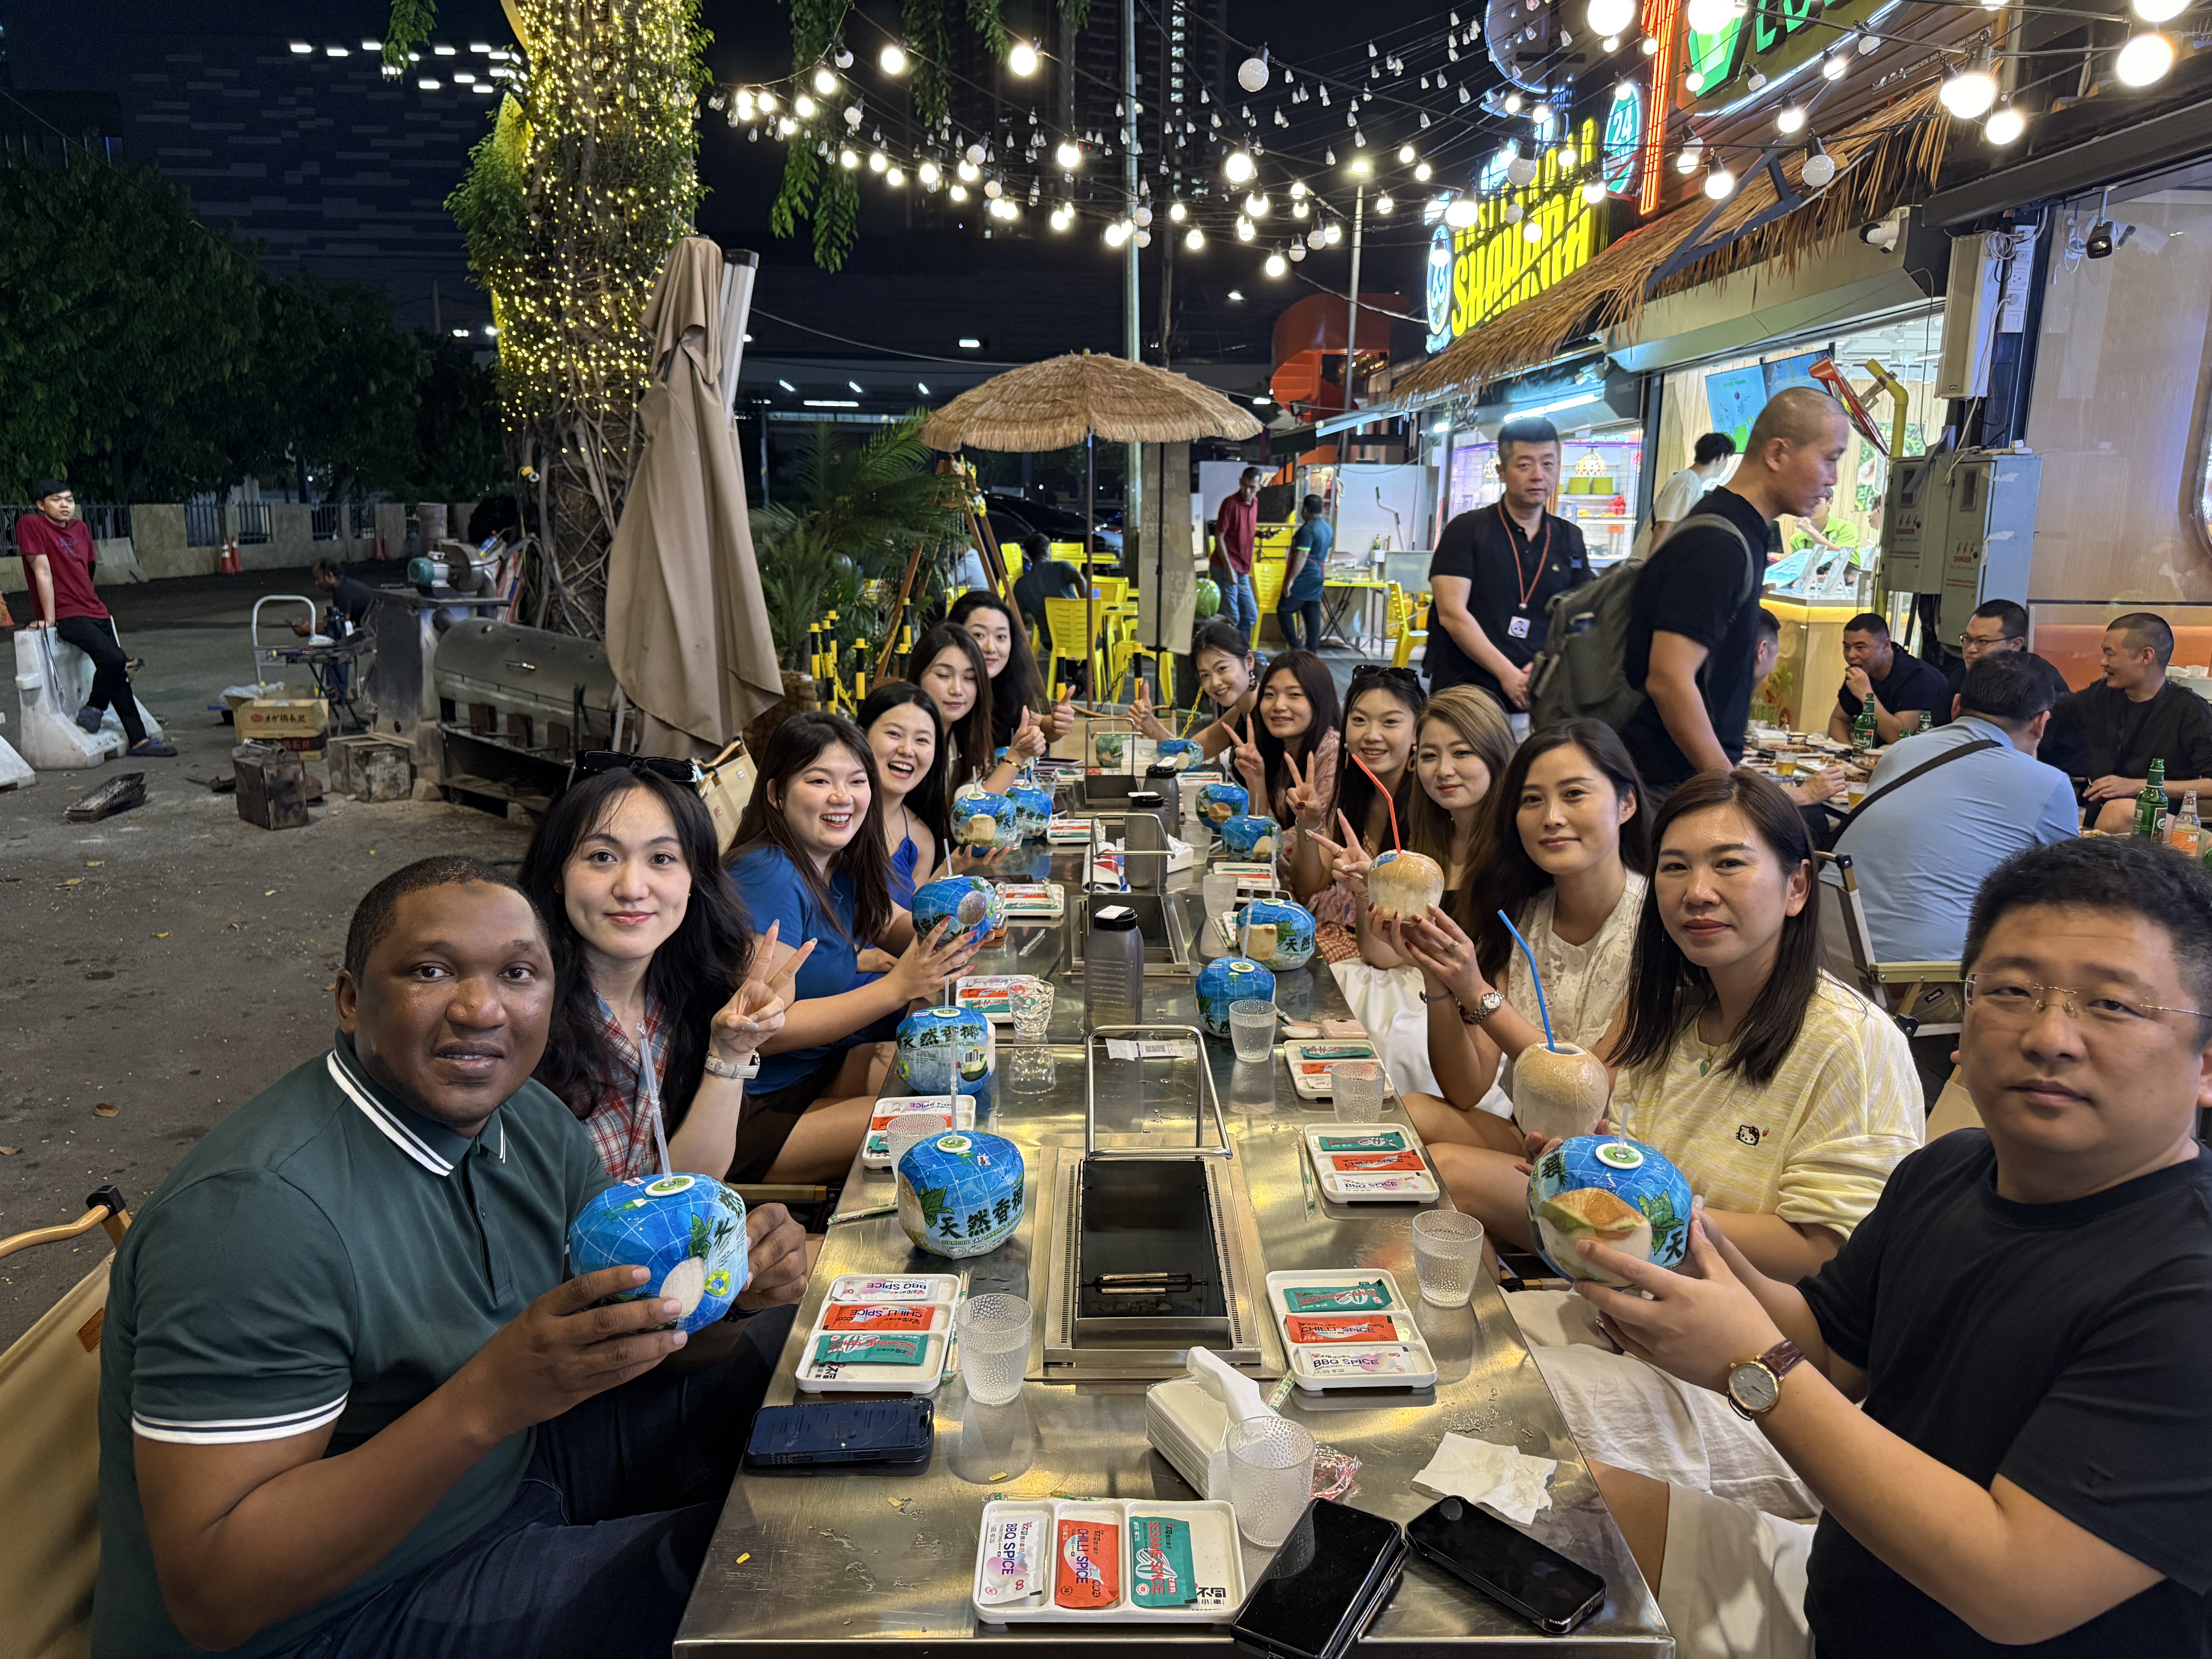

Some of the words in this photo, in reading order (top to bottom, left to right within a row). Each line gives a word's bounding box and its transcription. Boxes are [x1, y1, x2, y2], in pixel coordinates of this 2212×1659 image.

[1611, 101, 1632, 151] 24
[984, 1225, 1006, 1240] PANDAN
[1314, 1359, 1339, 1368] BBQ
[1004, 1523, 1018, 1540] BBQ
[1077, 1528, 1089, 1552] CHILLI
[1149, 1522, 1163, 1559] SESAME
[1001, 1542, 1016, 1575] SPICE
[1076, 1556, 1089, 1584] SPICE
[1151, 1561, 1165, 1595] SPICE
[1197, 1587, 1226, 1598] 不同
